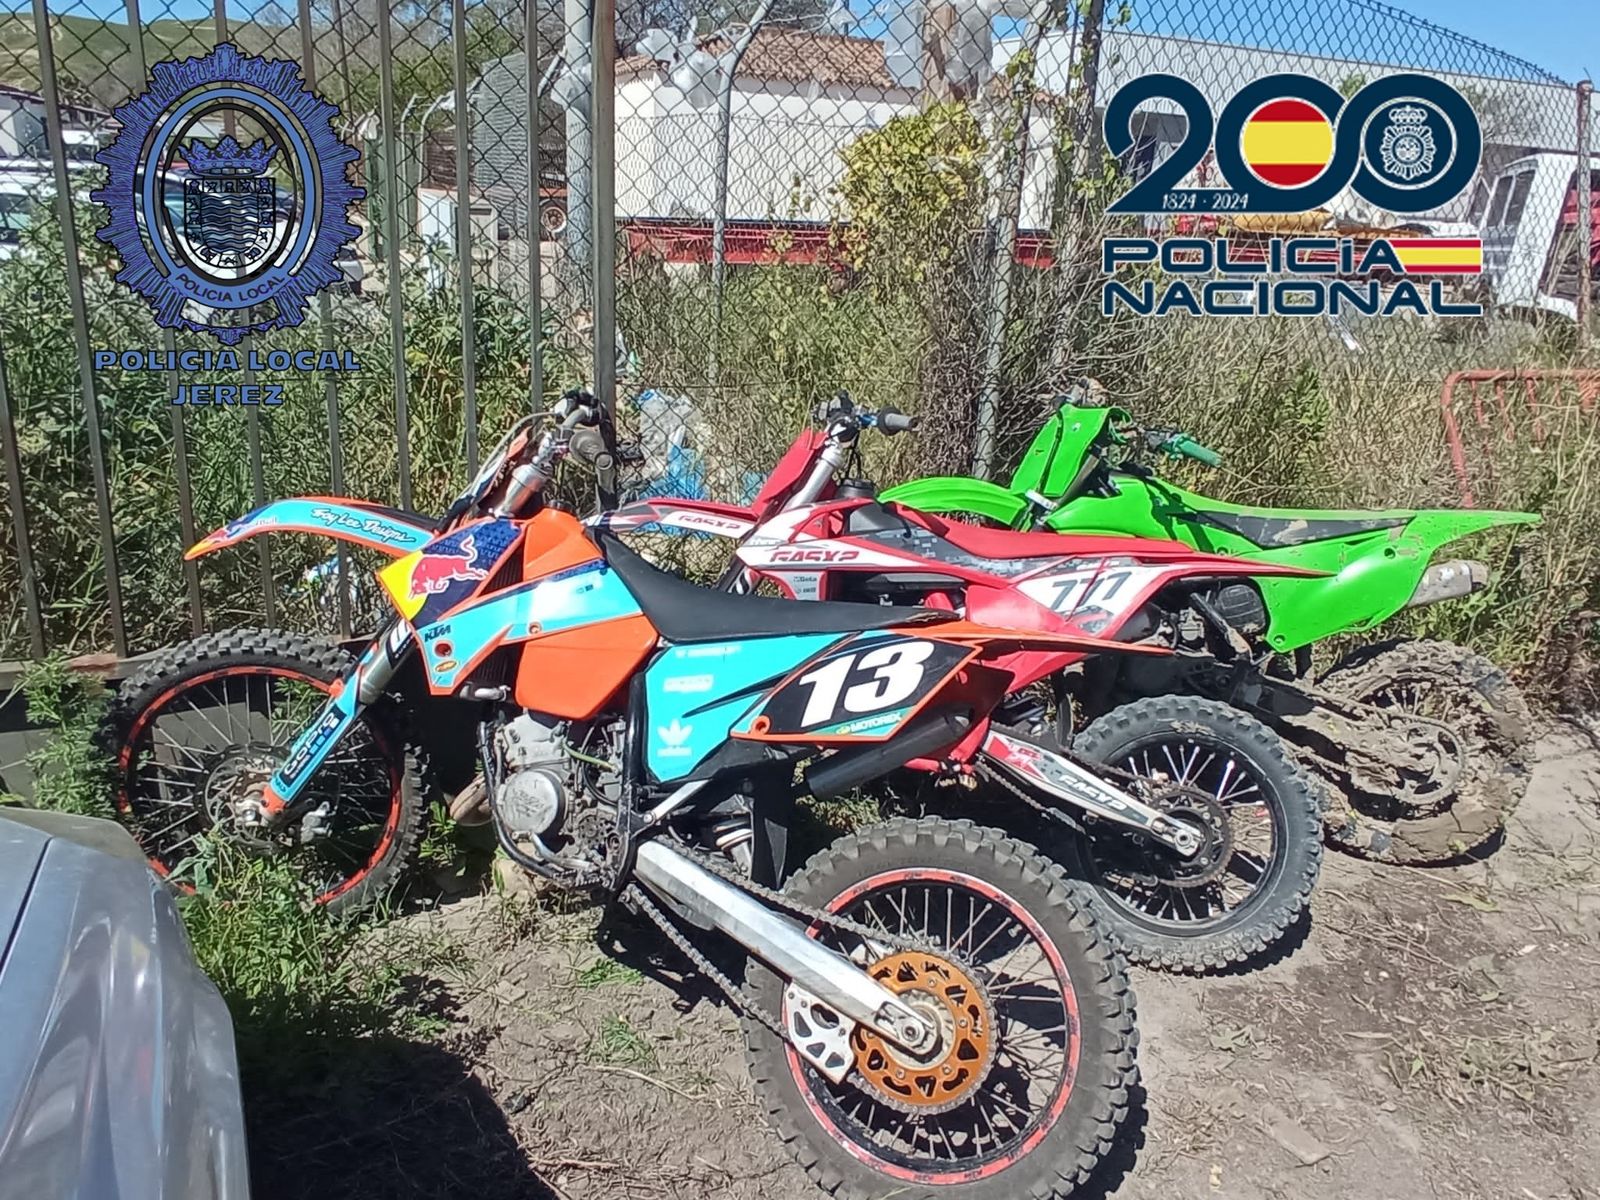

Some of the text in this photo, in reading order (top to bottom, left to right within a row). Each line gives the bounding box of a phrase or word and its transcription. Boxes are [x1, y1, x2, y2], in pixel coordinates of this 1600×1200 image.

[311, 508, 417, 543] Troy Lee Designs
[1050, 571, 1132, 611] 777
[424, 624, 452, 643] KTM
[799, 641, 934, 728] 13
[850, 711, 902, 732] MOTOREX
[283, 712, 335, 776] GoPro
